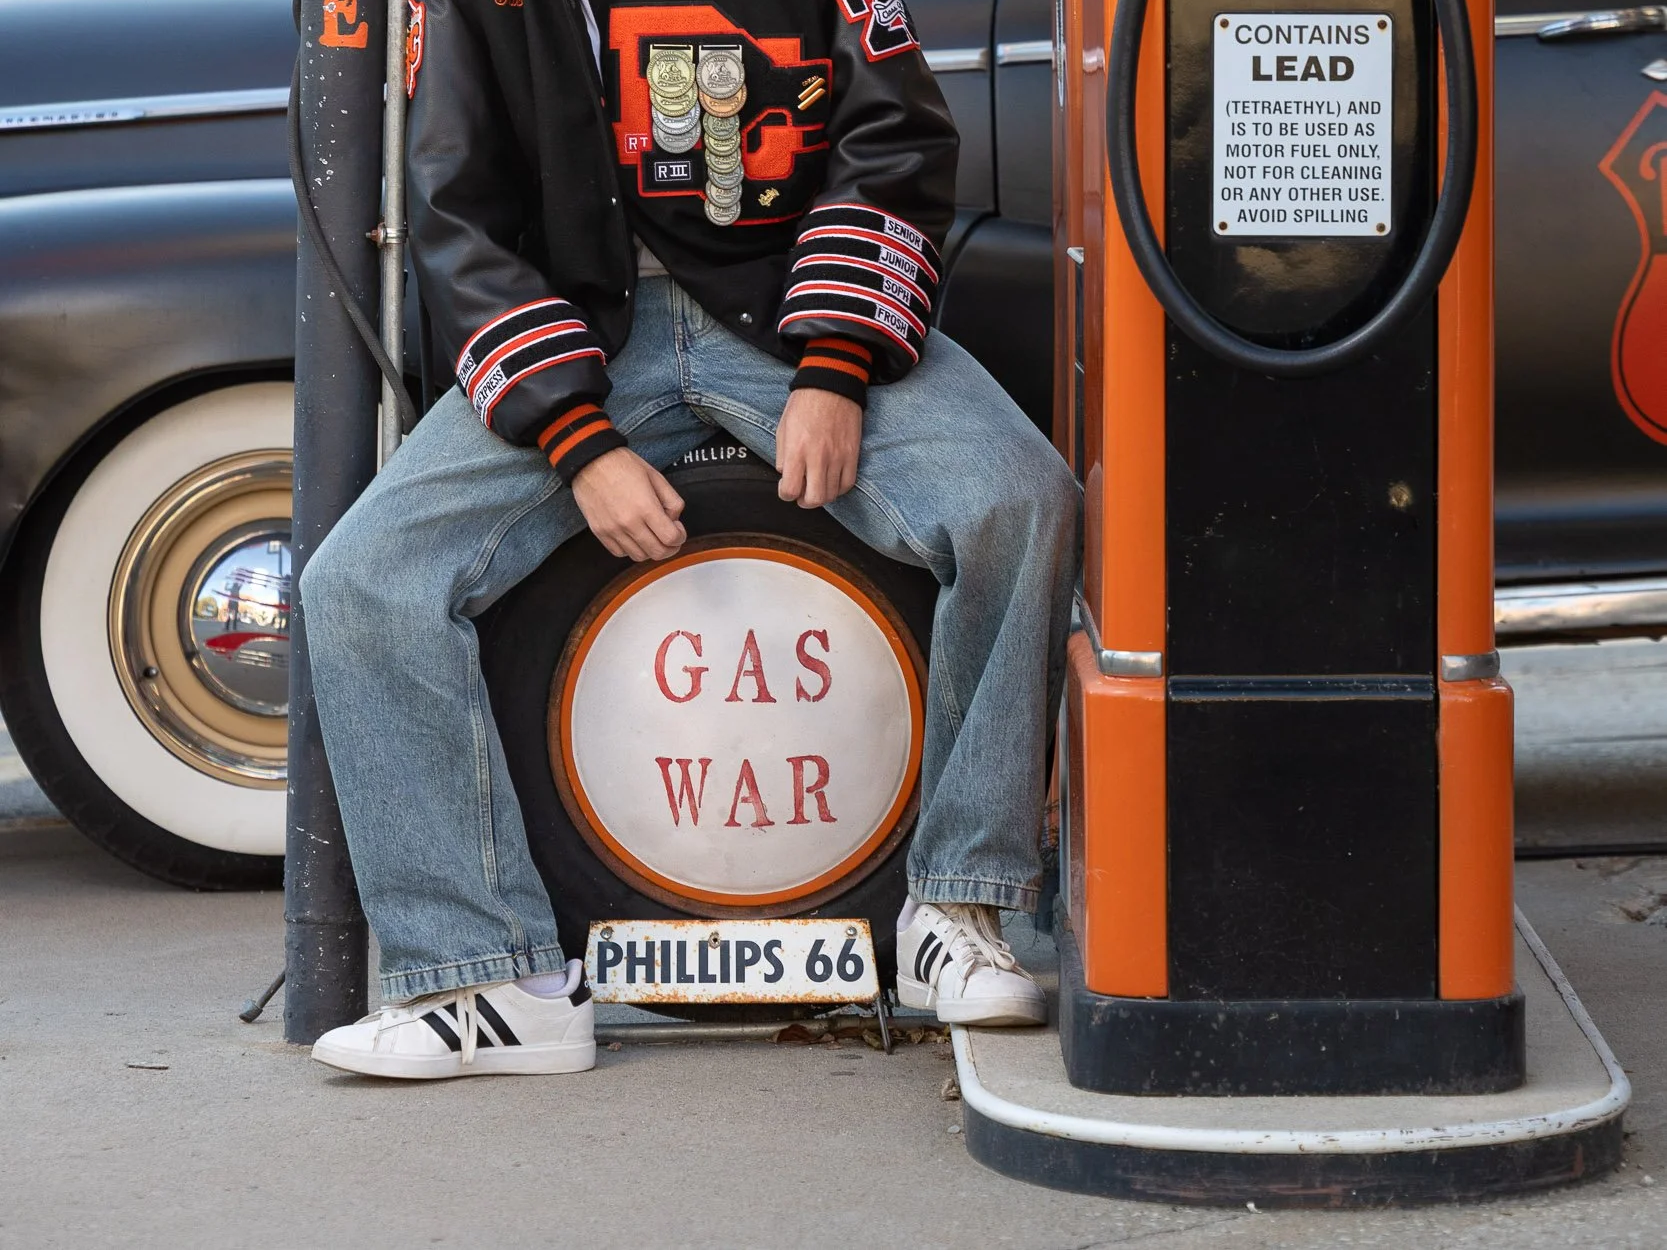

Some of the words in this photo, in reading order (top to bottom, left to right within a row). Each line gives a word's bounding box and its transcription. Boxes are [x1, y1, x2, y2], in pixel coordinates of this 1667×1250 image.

[1235, 25, 1370, 44] CONTAINS
[1252, 56, 1355, 81] LEAD
[1226, 101, 1341, 116] (TETRAETHYL)
[1347, 101, 1381, 115] AND
[1231, 122, 1246, 137] IS
[1252, 122, 1273, 137] TO
[1279, 122, 1299, 137] BE
[1305, 122, 1348, 137] USED
[1354, 122, 1375, 137] AS
[1226, 144, 1285, 159] MOTOR
[1291, 144, 1332, 158] FUEL
[1337, 144, 1380, 160] ONLY,
[1224, 165, 1257, 180] NOT
[1263, 165, 1295, 180] FOR
[1300, 165, 1382, 180] CLEANING
[1221, 187, 1244, 202] OR
[1249, 187, 1282, 202] ANY
[1288, 187, 1342, 202] OTHER
[1348, 187, 1385, 202] USE.
[1237, 209, 1287, 223] AVOID
[1293, 209, 1369, 223] SPILLING
[887, 220, 922, 248] SENIOR
[881, 251, 916, 280] JUNIOR
[884, 279, 910, 304] SOPH
[877, 308, 908, 334] FROSH
[477, 369, 504, 404] EXPRESS
[673, 447, 747, 466] HILLIPS
[654, 629, 831, 704] GAS
[655, 754, 837, 828] WAR
[597, 938, 785, 984] PHILLIPS
[805, 938, 864, 983] 66
